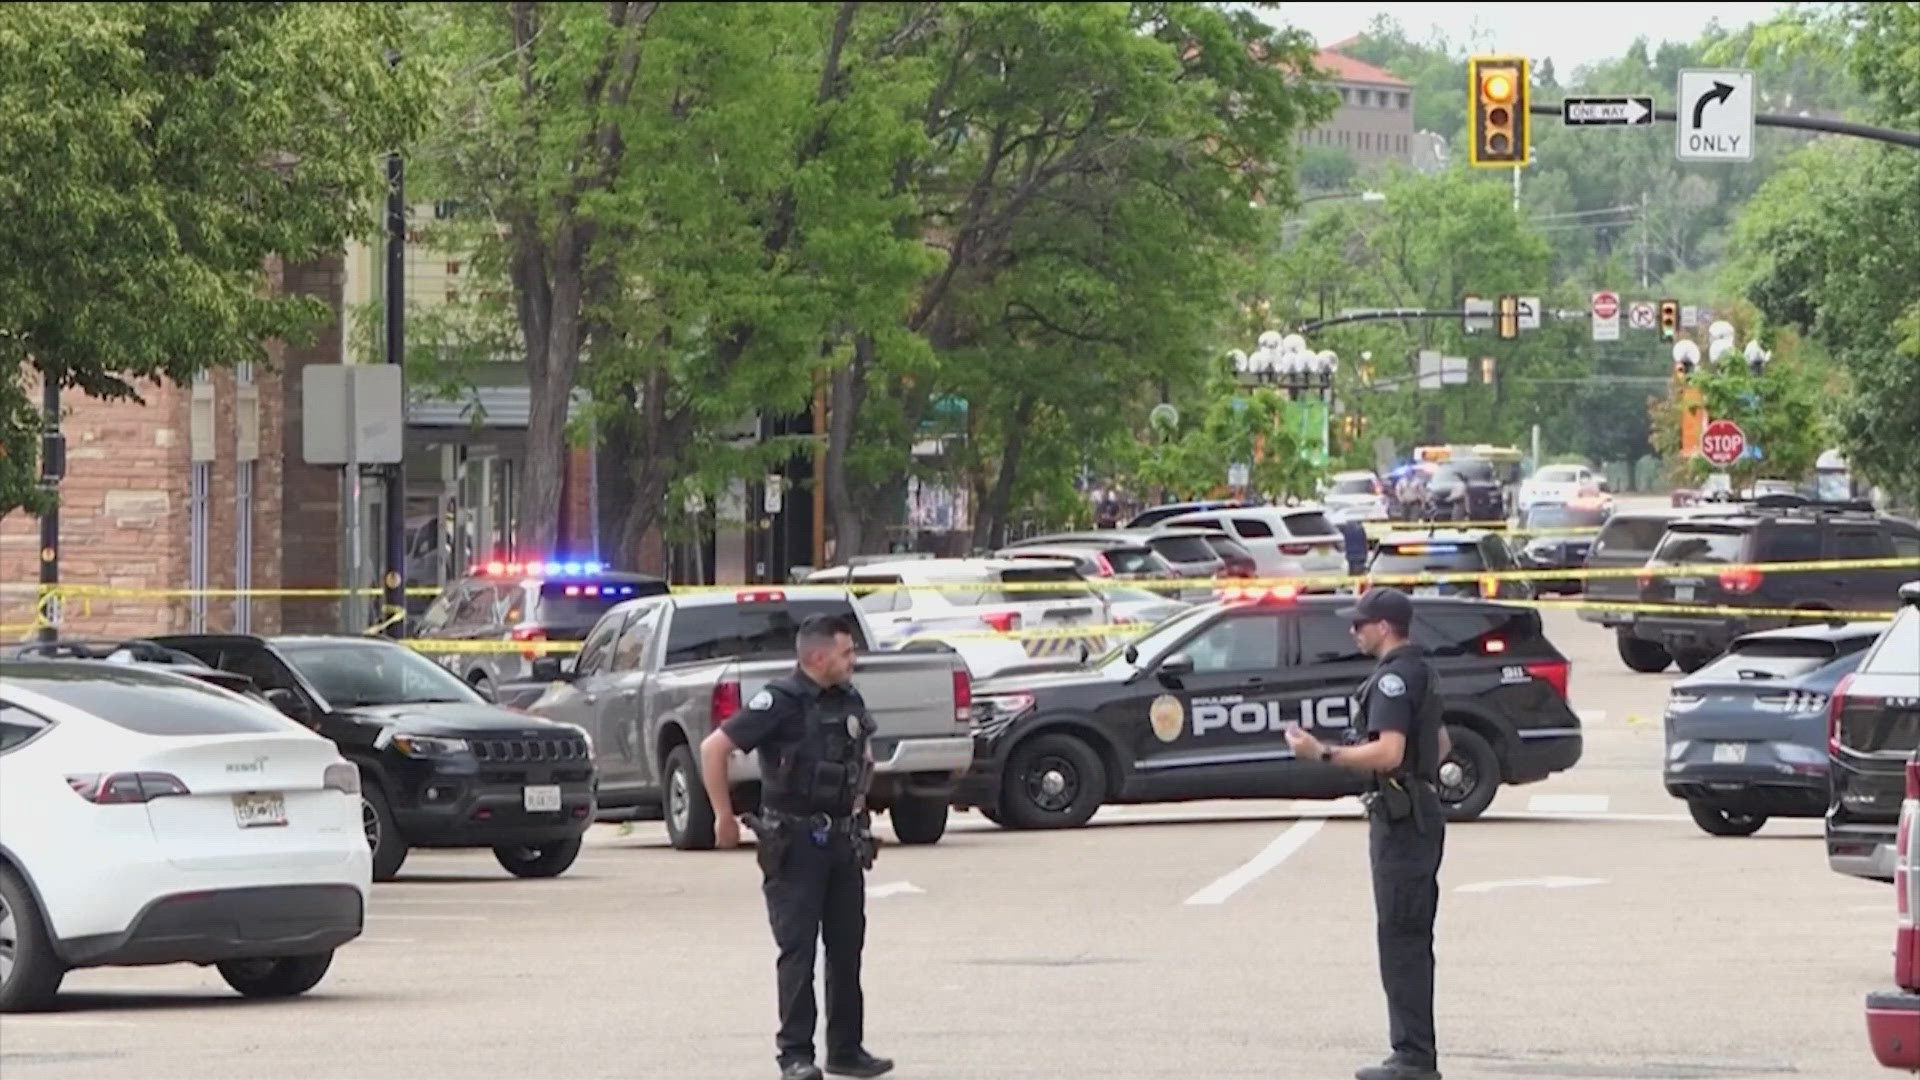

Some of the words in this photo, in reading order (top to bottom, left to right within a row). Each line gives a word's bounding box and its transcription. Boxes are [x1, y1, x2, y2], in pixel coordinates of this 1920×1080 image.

[1572, 106, 1597, 117] ONE
[1601, 106, 1626, 117] WAY
[1689, 134, 1741, 152] ONLY
[1704, 434, 1741, 453] STOP
